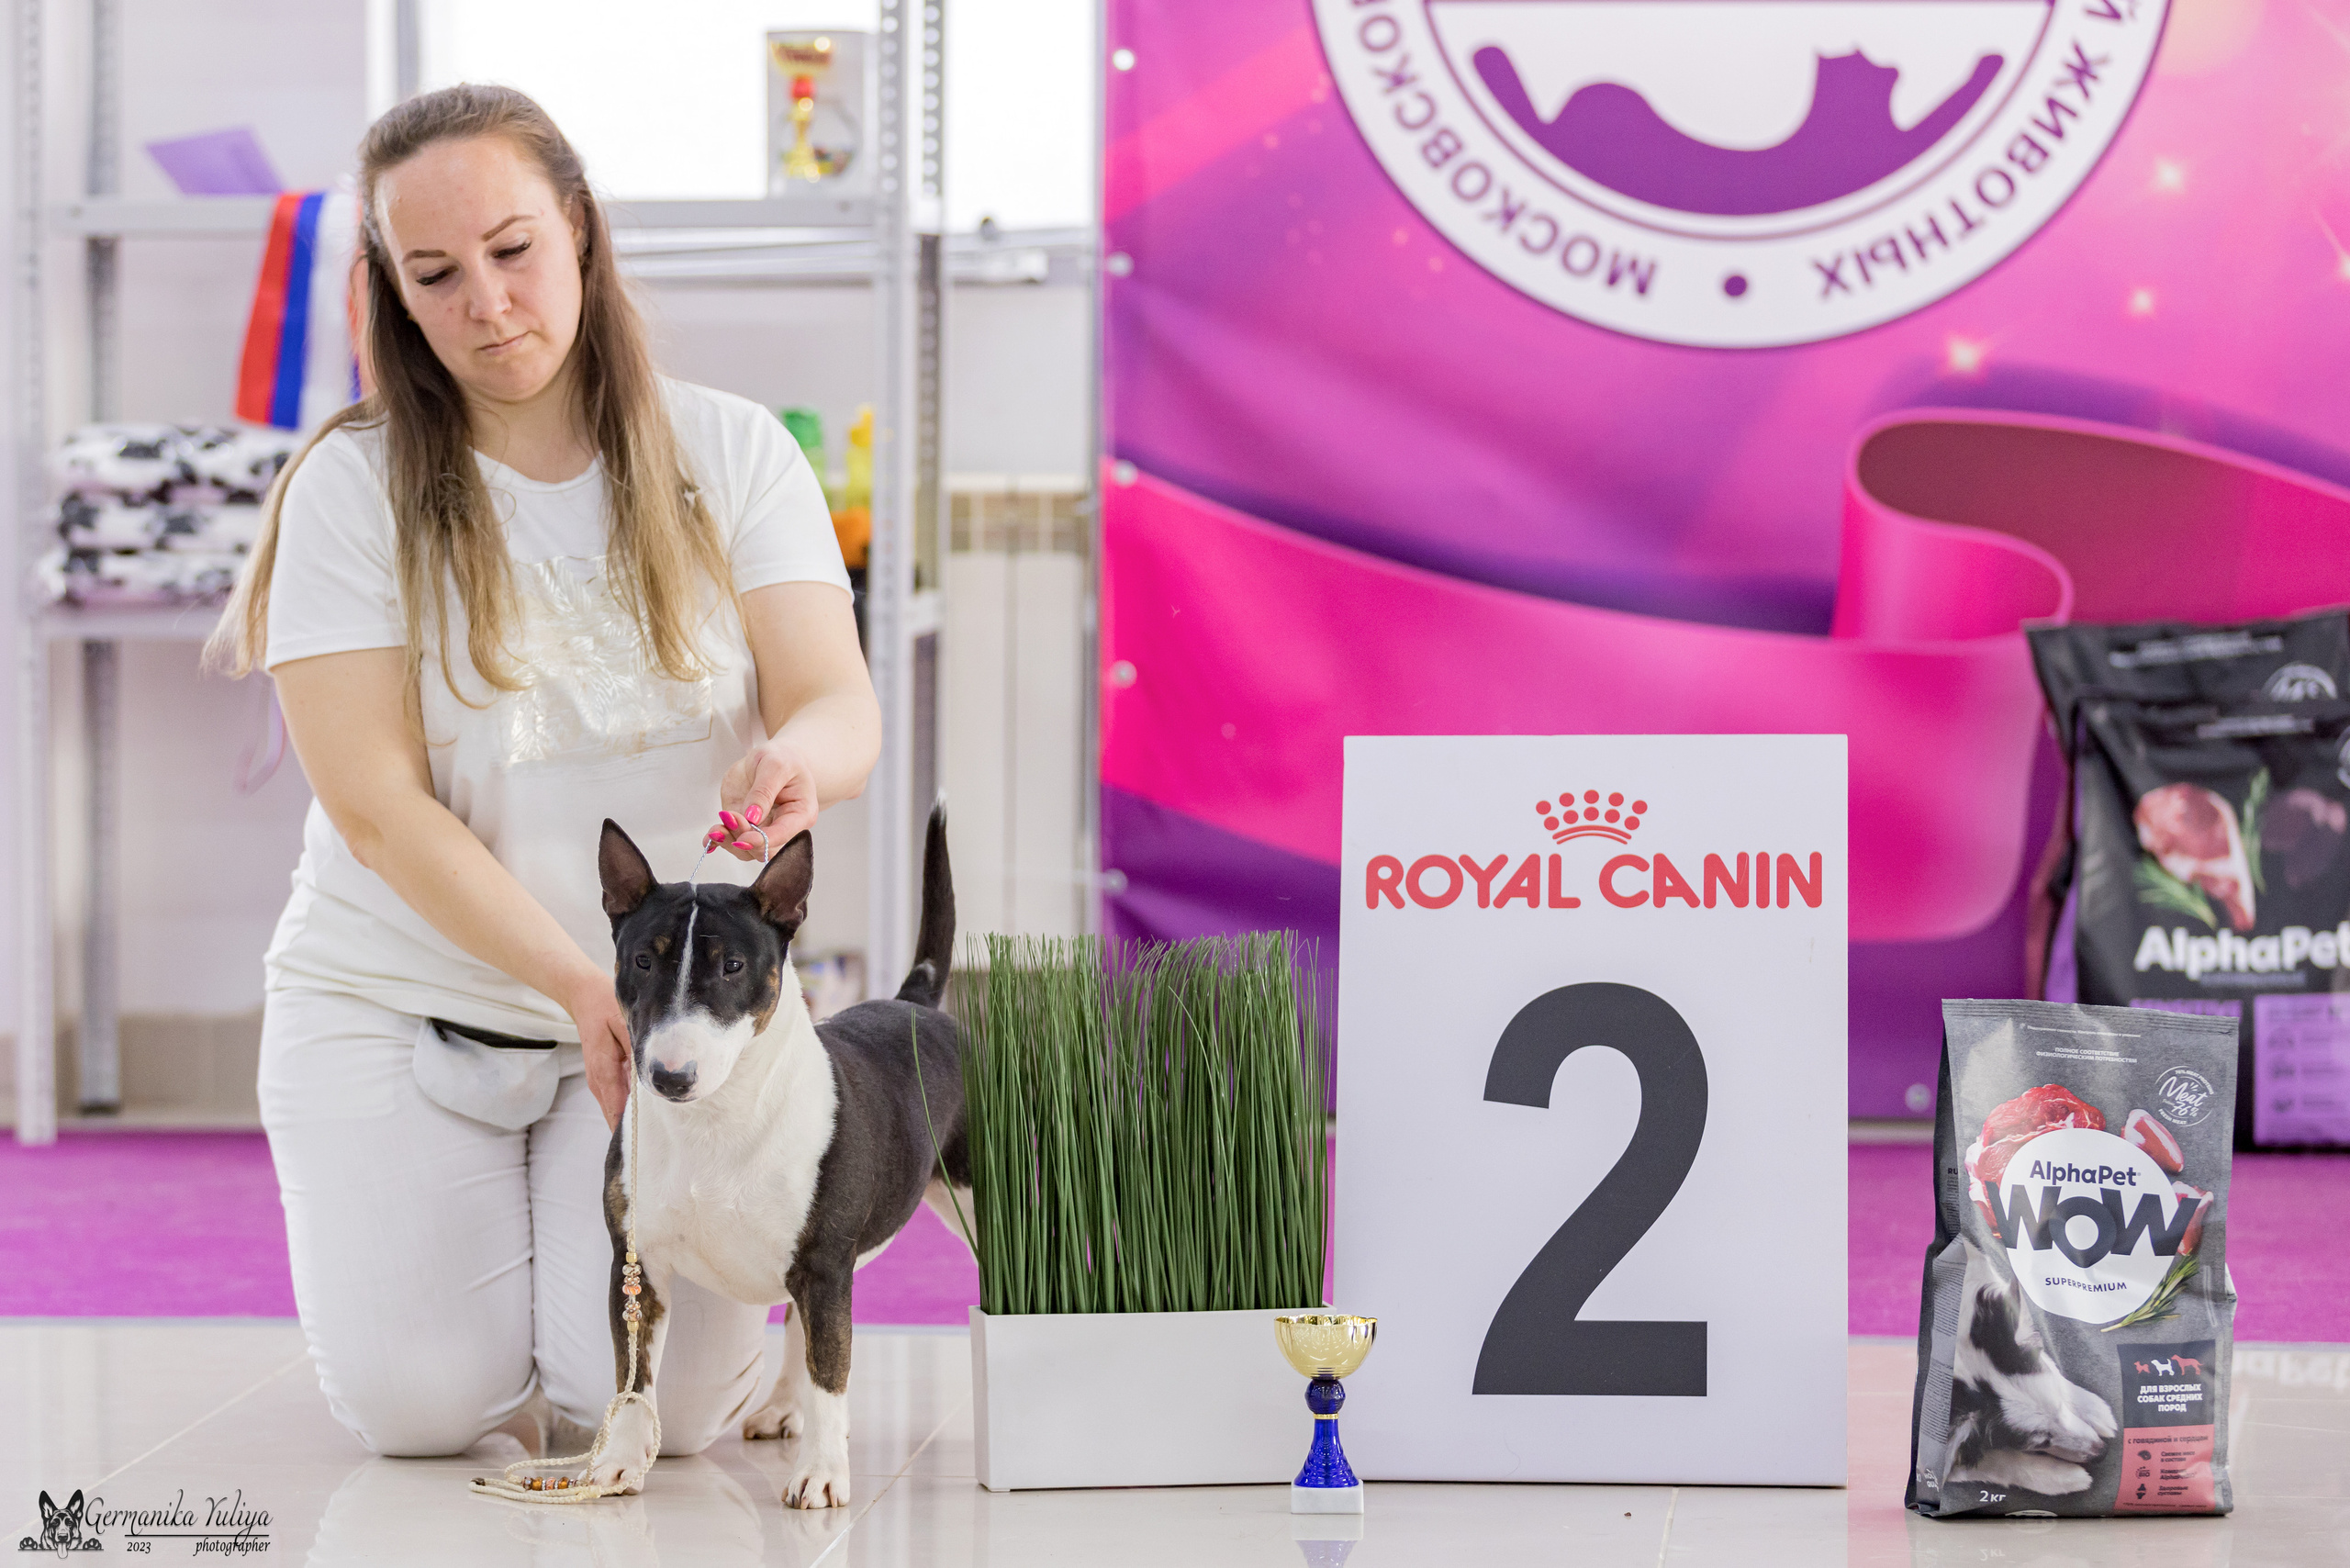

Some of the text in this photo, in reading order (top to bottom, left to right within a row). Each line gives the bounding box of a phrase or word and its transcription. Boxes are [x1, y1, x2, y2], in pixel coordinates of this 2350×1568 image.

[1352, 0, 1656, 297] МОСКОВСКО
[1811, 40, 2109, 299] ЖИВОТНЫХ
[1365, 850, 1823, 910] ROYAL CANIN
[2054, 1047, 2120, 1058] ПОЛНОЕ СООТВЕТСТВИЕ
[2158, 1076, 2209, 1107] Meat
[2171, 1101, 2199, 1117] 76%
[2030, 1159, 2136, 1186] AlphaPet
[1472, 982, 1709, 1397] 2
[1985, 1181, 2202, 1269] WOW
[2044, 1277, 2128, 1293] SUPERPREMIUM
[2140, 1383, 2202, 1394] ДЛЯ ВЗРОСЛЫХ
[2137, 1393, 2203, 1404] СОБАК СРЕДНИХ
[2157, 1403, 2188, 1413] ПОРОД
[2132, 1435, 2172, 1445] говядиной
[1979, 1490, 2007, 1503] 2 кг
